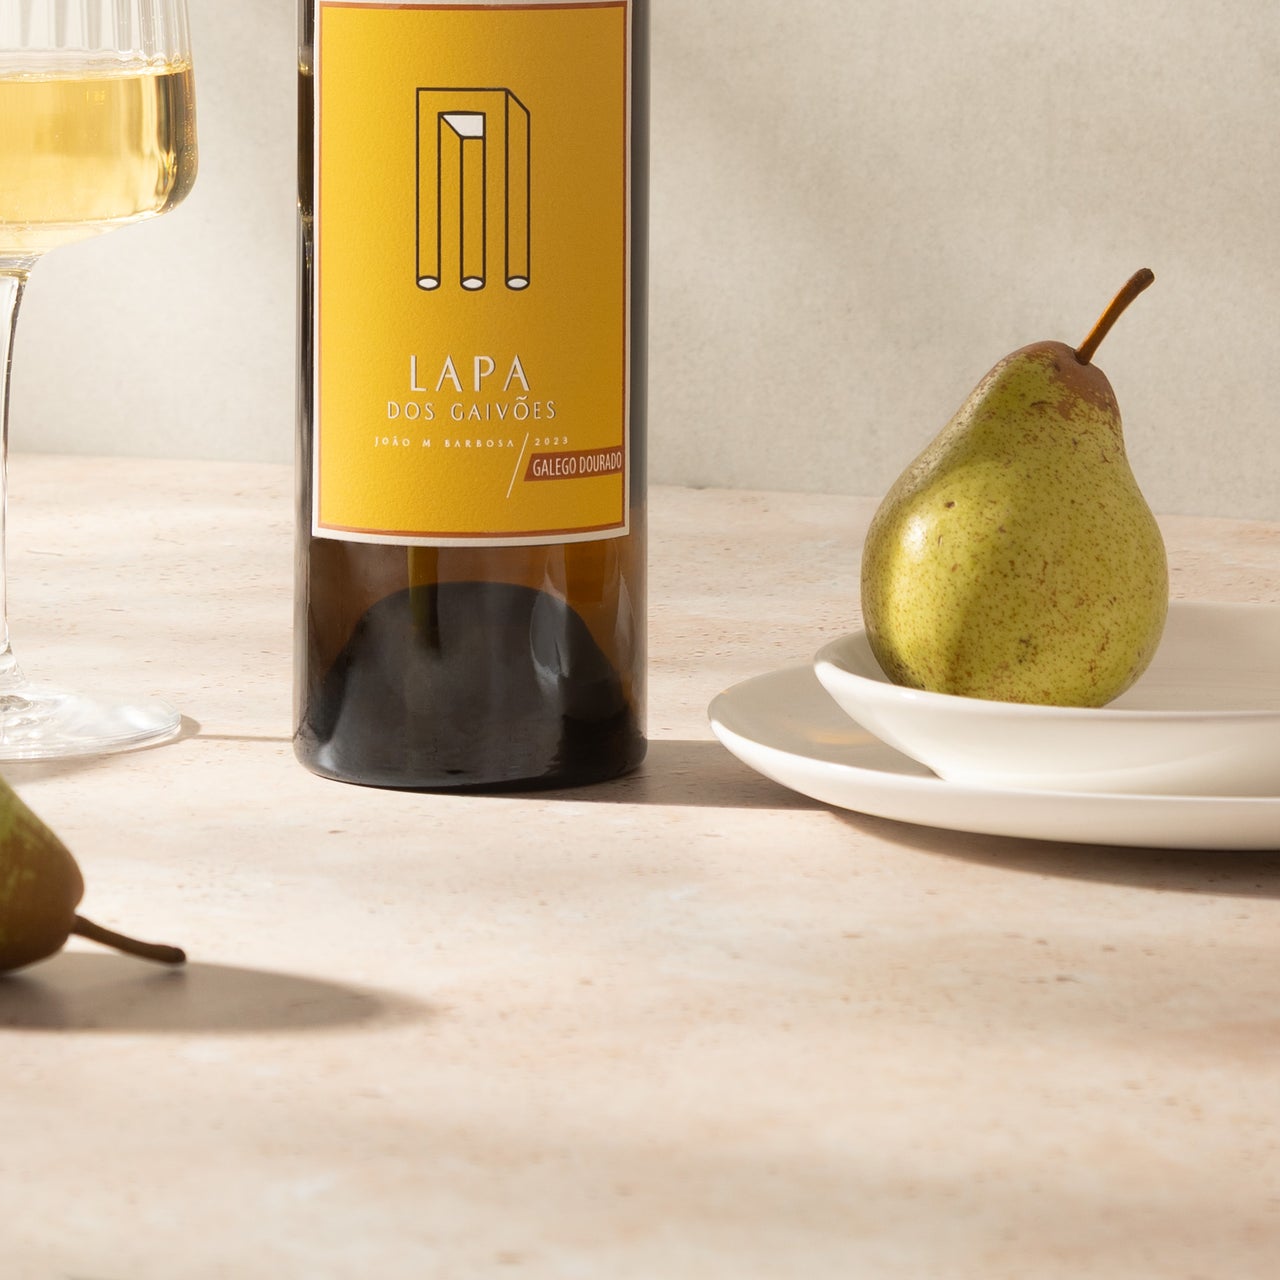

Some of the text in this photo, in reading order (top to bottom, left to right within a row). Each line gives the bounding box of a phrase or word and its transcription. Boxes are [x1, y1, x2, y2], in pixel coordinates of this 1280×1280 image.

[409, 354, 531, 392] LAPA
[386, 396, 557, 421] DOS GAIVÕES
[374, 435, 569, 449] JOÃO M BARBOSA 2023
[532, 451, 622, 478] GALEGO DOURADO
